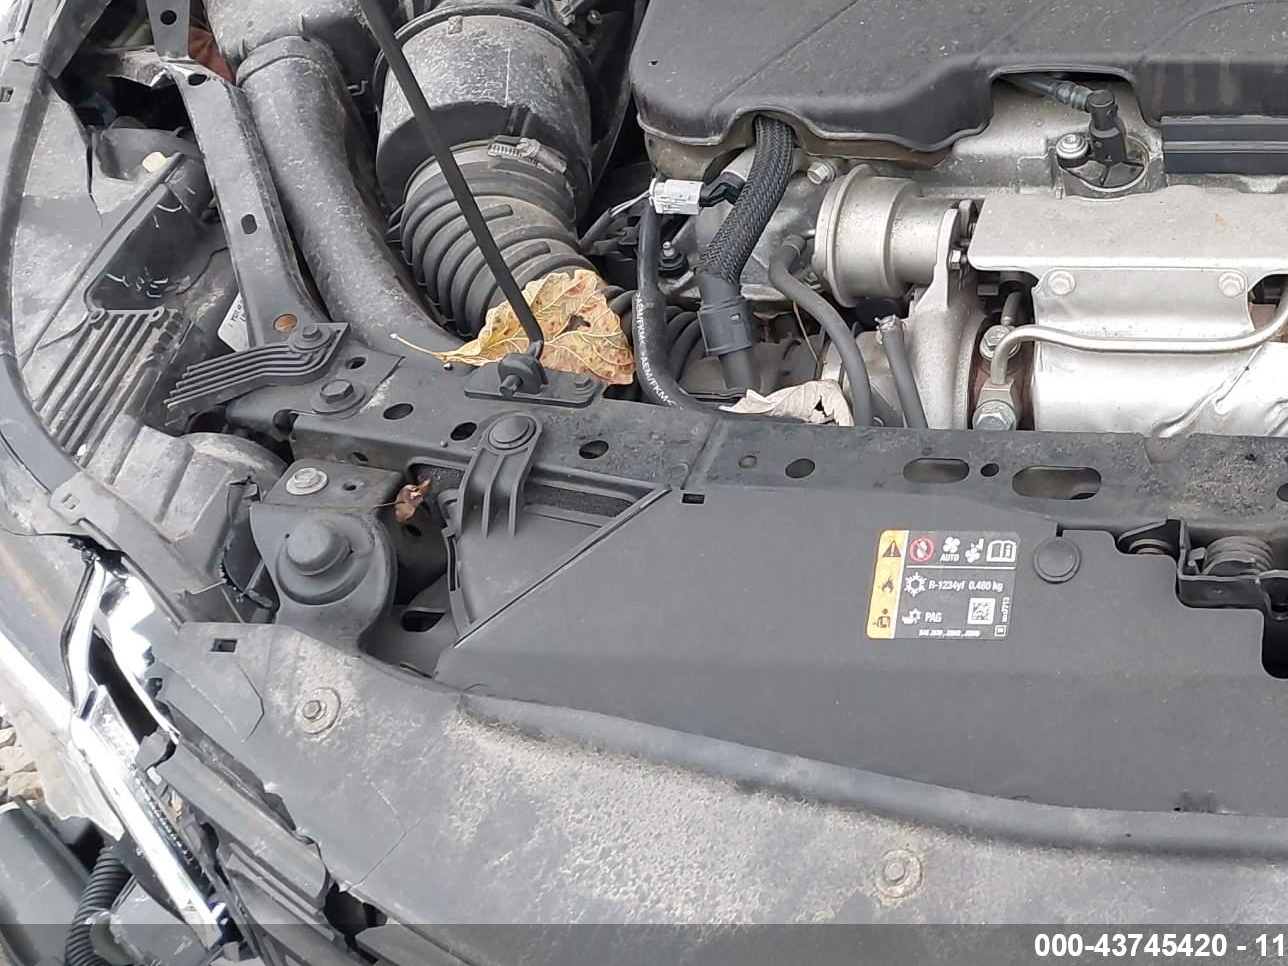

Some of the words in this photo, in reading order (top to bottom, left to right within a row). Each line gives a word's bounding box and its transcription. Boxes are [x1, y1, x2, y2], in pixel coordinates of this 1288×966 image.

[940, 553, 960, 562] AUTO
[928, 580, 965, 591] R-1234yf
[992, 580, 1004, 593] kg
[924, 612, 943, 623] PAG
